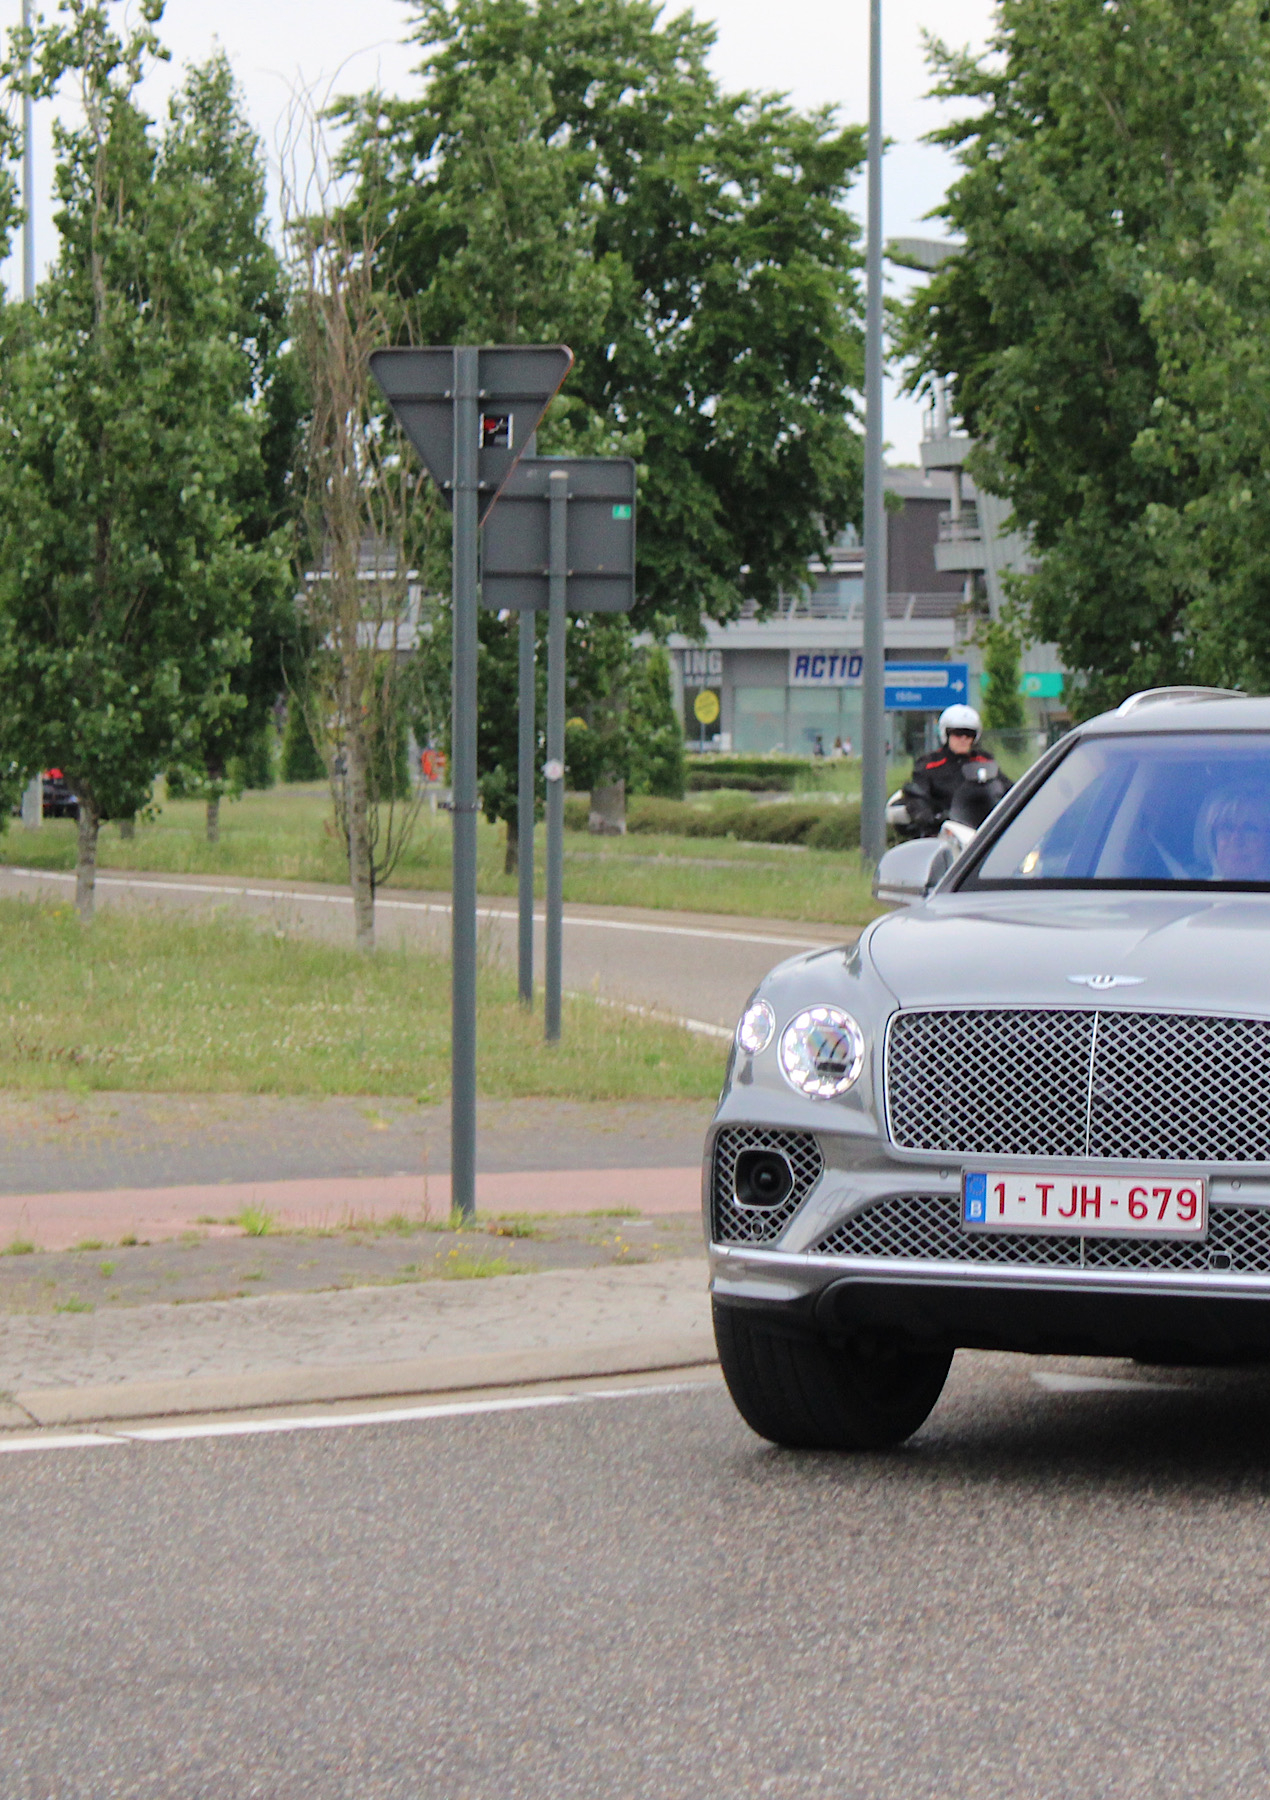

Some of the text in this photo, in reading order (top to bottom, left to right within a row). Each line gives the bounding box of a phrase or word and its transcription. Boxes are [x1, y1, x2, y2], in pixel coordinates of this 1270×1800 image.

[795, 655, 863, 678] ACTIO
[970, 1201, 982, 1217] B
[994, 1183, 1198, 1221] 1-TJH-679
